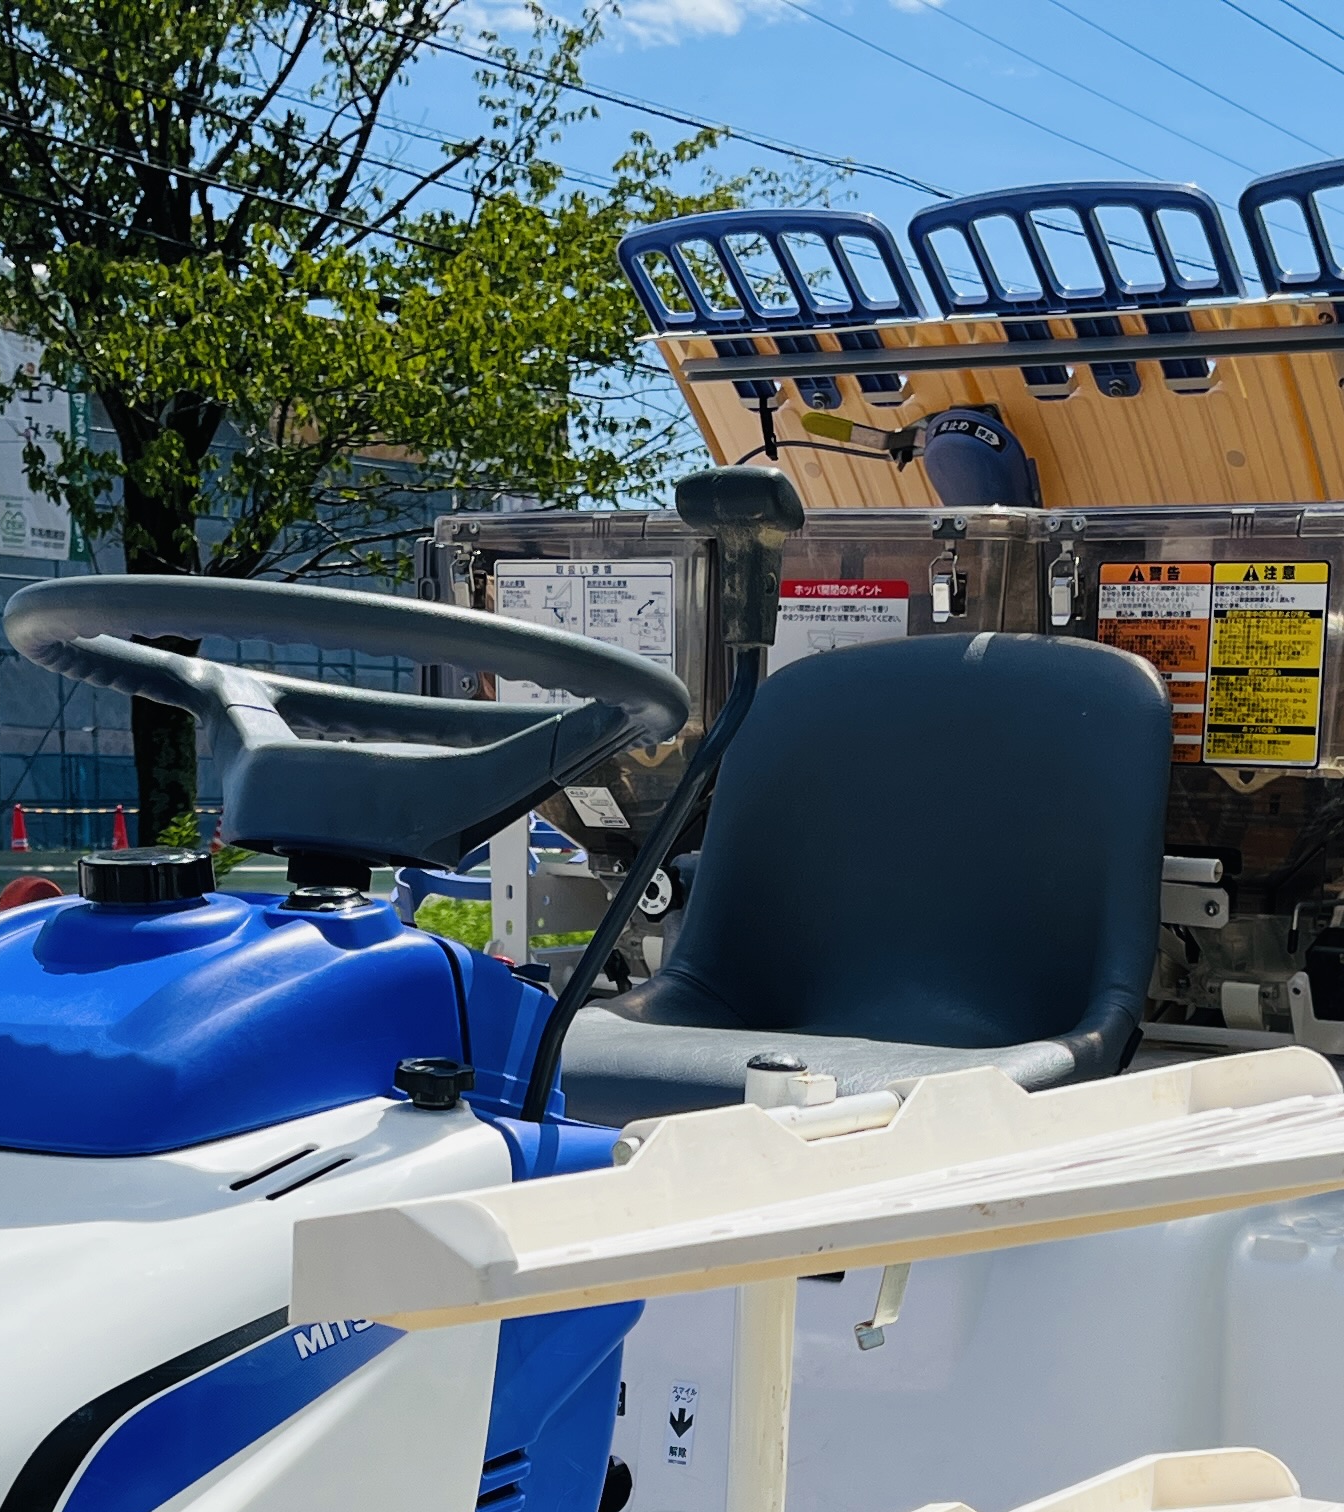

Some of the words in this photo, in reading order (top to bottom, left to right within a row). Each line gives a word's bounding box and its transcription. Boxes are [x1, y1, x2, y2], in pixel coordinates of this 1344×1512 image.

[1263, 565, 1297, 581] 注意
[674, 1394, 694, 1403] ターン
[668, 1446, 687, 1459] 解除
